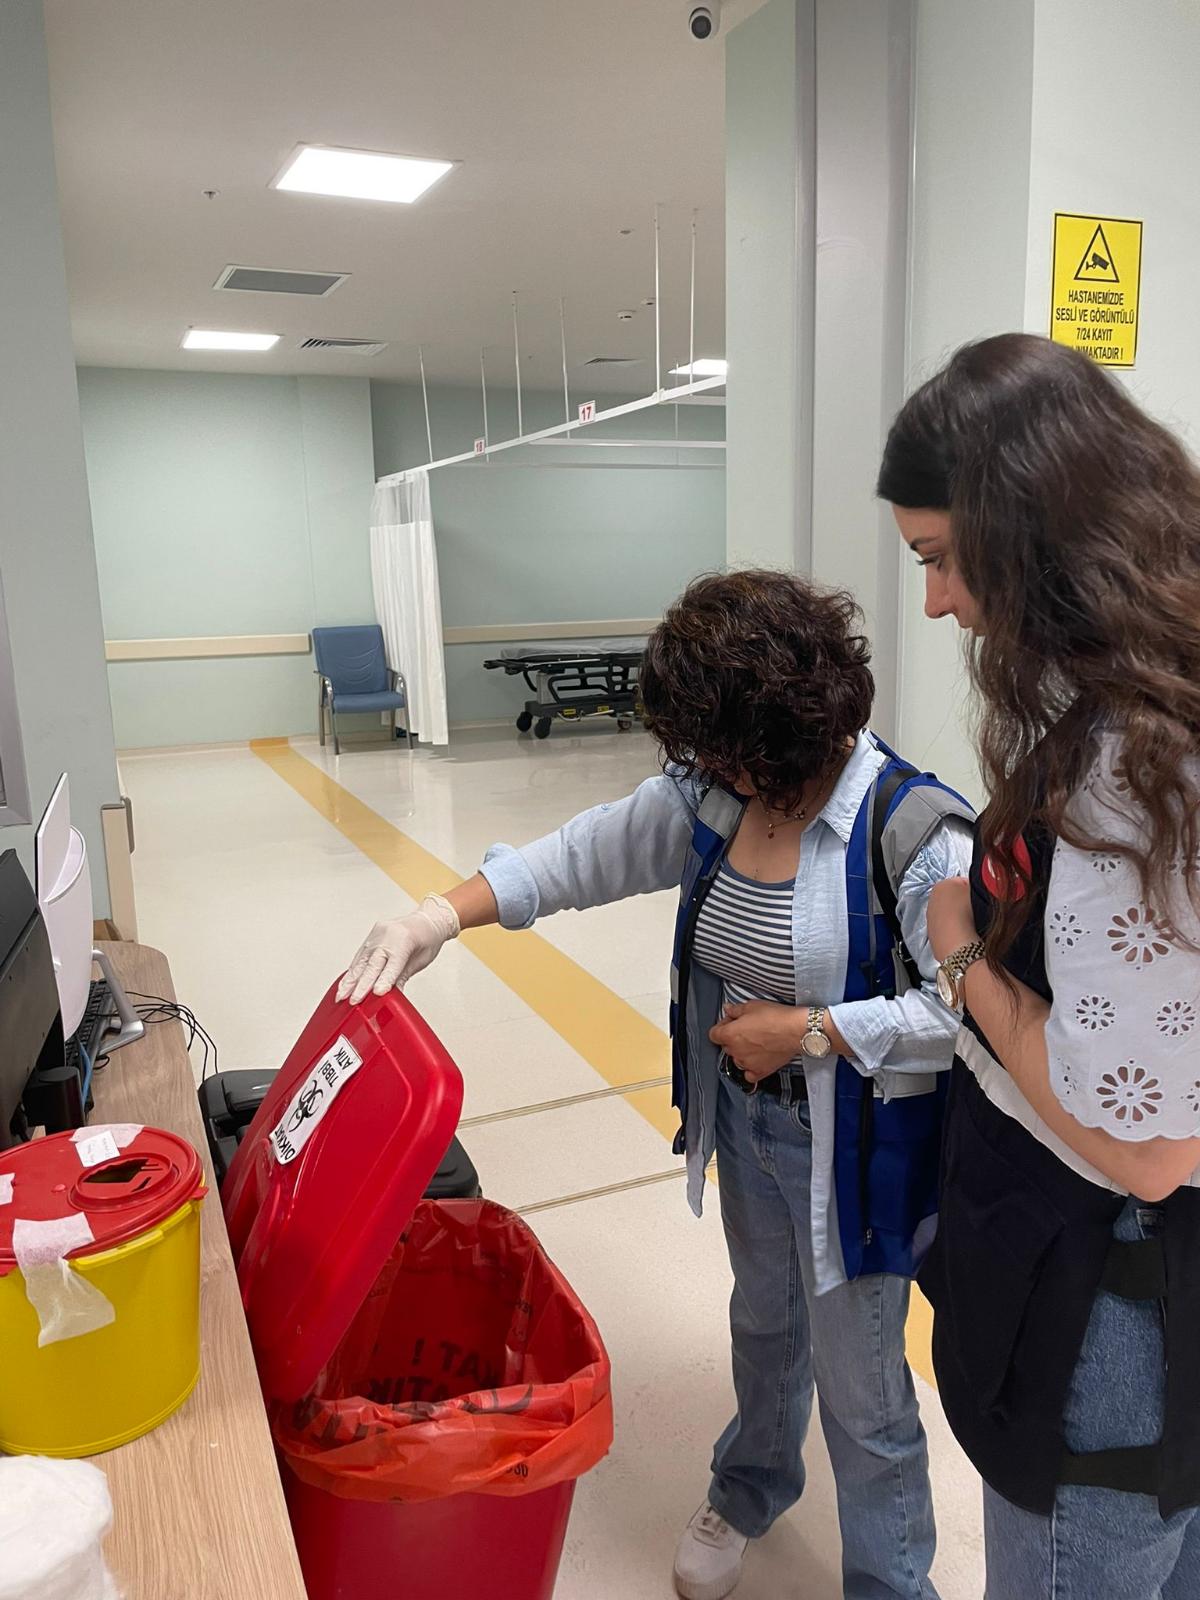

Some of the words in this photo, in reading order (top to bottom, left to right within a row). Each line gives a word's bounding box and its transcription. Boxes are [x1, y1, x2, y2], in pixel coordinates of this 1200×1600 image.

[1068, 289, 1124, 306] HASTANEMİZDE
[1056, 306, 1077, 321] SESLİ
[1079, 309, 1088, 322] VE
[1090, 307, 1134, 325] GÖRÜNTÜLÜ
[1077, 327, 1090, 340] 7/24
[1092, 328, 1113, 341] KAYIT
[581, 406, 592, 421] 17
[333, 1047, 354, 1071] ATIK
[317, 1060, 339, 1088] TIBBİ
[274, 1123, 296, 1161] DİKKAT
